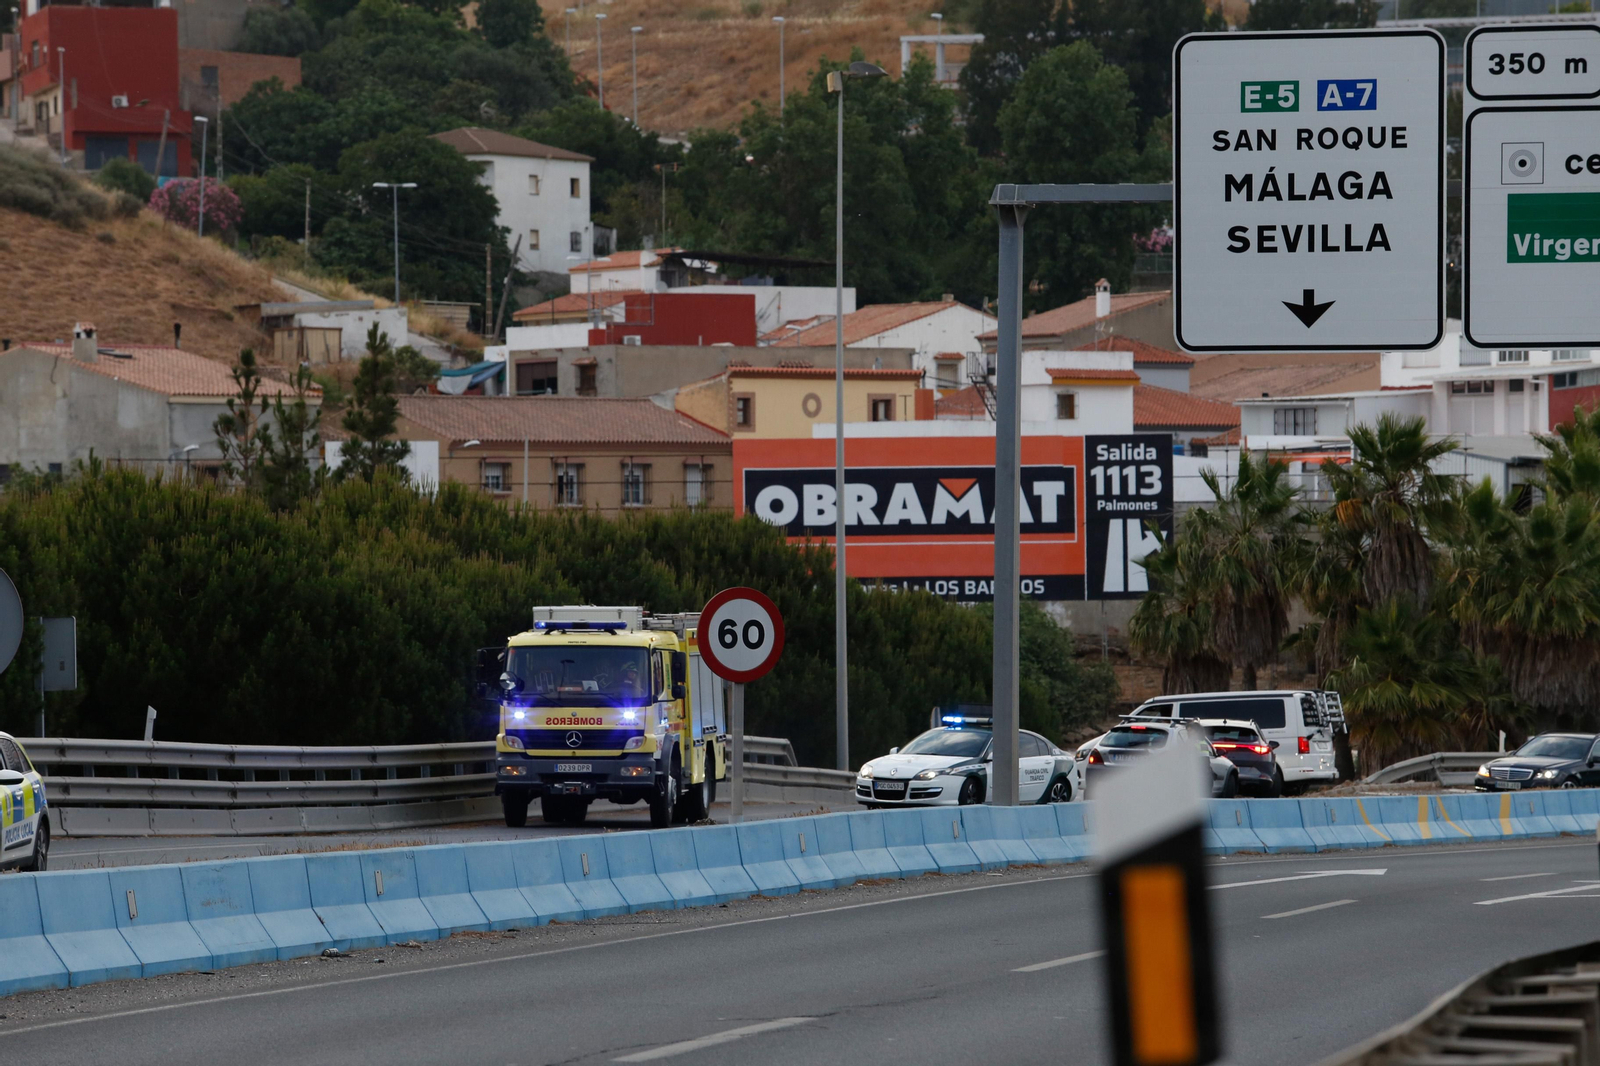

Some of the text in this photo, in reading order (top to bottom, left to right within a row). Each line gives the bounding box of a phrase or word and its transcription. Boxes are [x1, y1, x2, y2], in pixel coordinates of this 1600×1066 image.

[1488, 52, 1588, 75] 350 m
[1244, 83, 1374, 109] E-5 A-7
[1212, 126, 1408, 152] SAN ROQUE
[1224, 166, 1394, 202] MÁLAGA
[1226, 223, 1392, 254] SEVILLA
[1096, 443, 1157, 461] Salida
[1090, 464, 1162, 496] 1113
[1097, 499, 1158, 511] Palmones
[925, 580, 959, 596] LOS
[717, 618, 765, 650] 60
[558, 764, 576, 772] 0239
